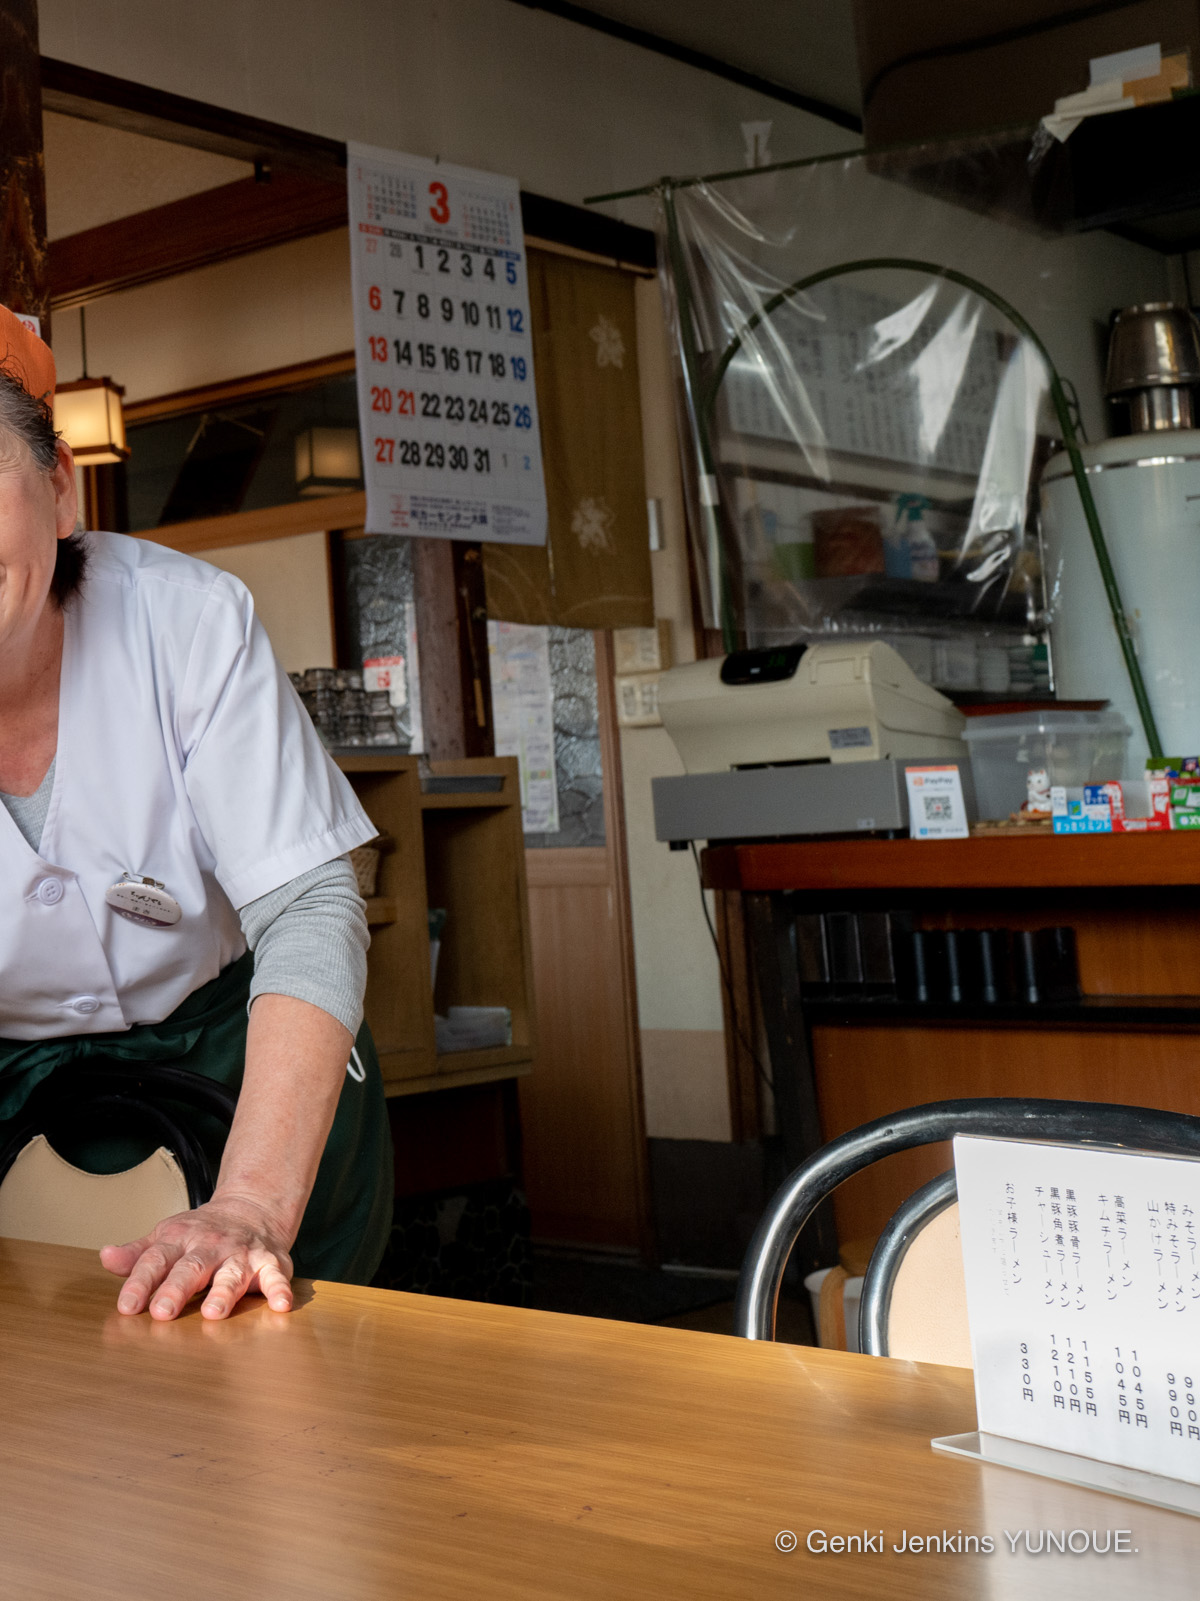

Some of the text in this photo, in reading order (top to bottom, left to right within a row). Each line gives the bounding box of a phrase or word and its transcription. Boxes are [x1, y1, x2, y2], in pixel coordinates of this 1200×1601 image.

[416, 245, 424, 269] 1
[437, 249, 450, 273] 2
[461, 253, 473, 277] 3
[484, 258, 495, 280] 4
[506, 261, 517, 285] 5
[428, 181, 450, 225] 3
[368, 286, 524, 333] 6 7 8 9 10 11 12
[368, 336, 527, 381] 13 14 15 16 17 18 19
[371, 386, 532, 429] 20 21 22 23 24 25 26
[375, 437, 396, 464] 27
[399, 440, 421, 466] 28
[424, 442, 445, 469] 29
[448, 444, 469, 471] 30
[473, 447, 490, 473] 31
[410, 510, 488, 525] カーセンター大
[1005, 1182, 1034, 1402] お子様ラーメン 330円
[1034, 1186, 1065, 1410] チャーシューメン 1210円
[1050, 1187, 1081, 1413] 黒豚角煮ラーメン 1210円
[1066, 1189, 1098, 1417] 黒豚豚骨ラーメン 1155円
[1097, 1194, 1131, 1425] キムチラーメン 1045円
[1114, 1195, 1148, 1429] 高菜ラーメン 1045円
[1147, 1199, 1183, 1437] 山かけラーメン 990円
[1165, 1202, 1200, 1440] 特みそラーメン 990円
[1182, 1204, 1200, 1299] みそラーメン
